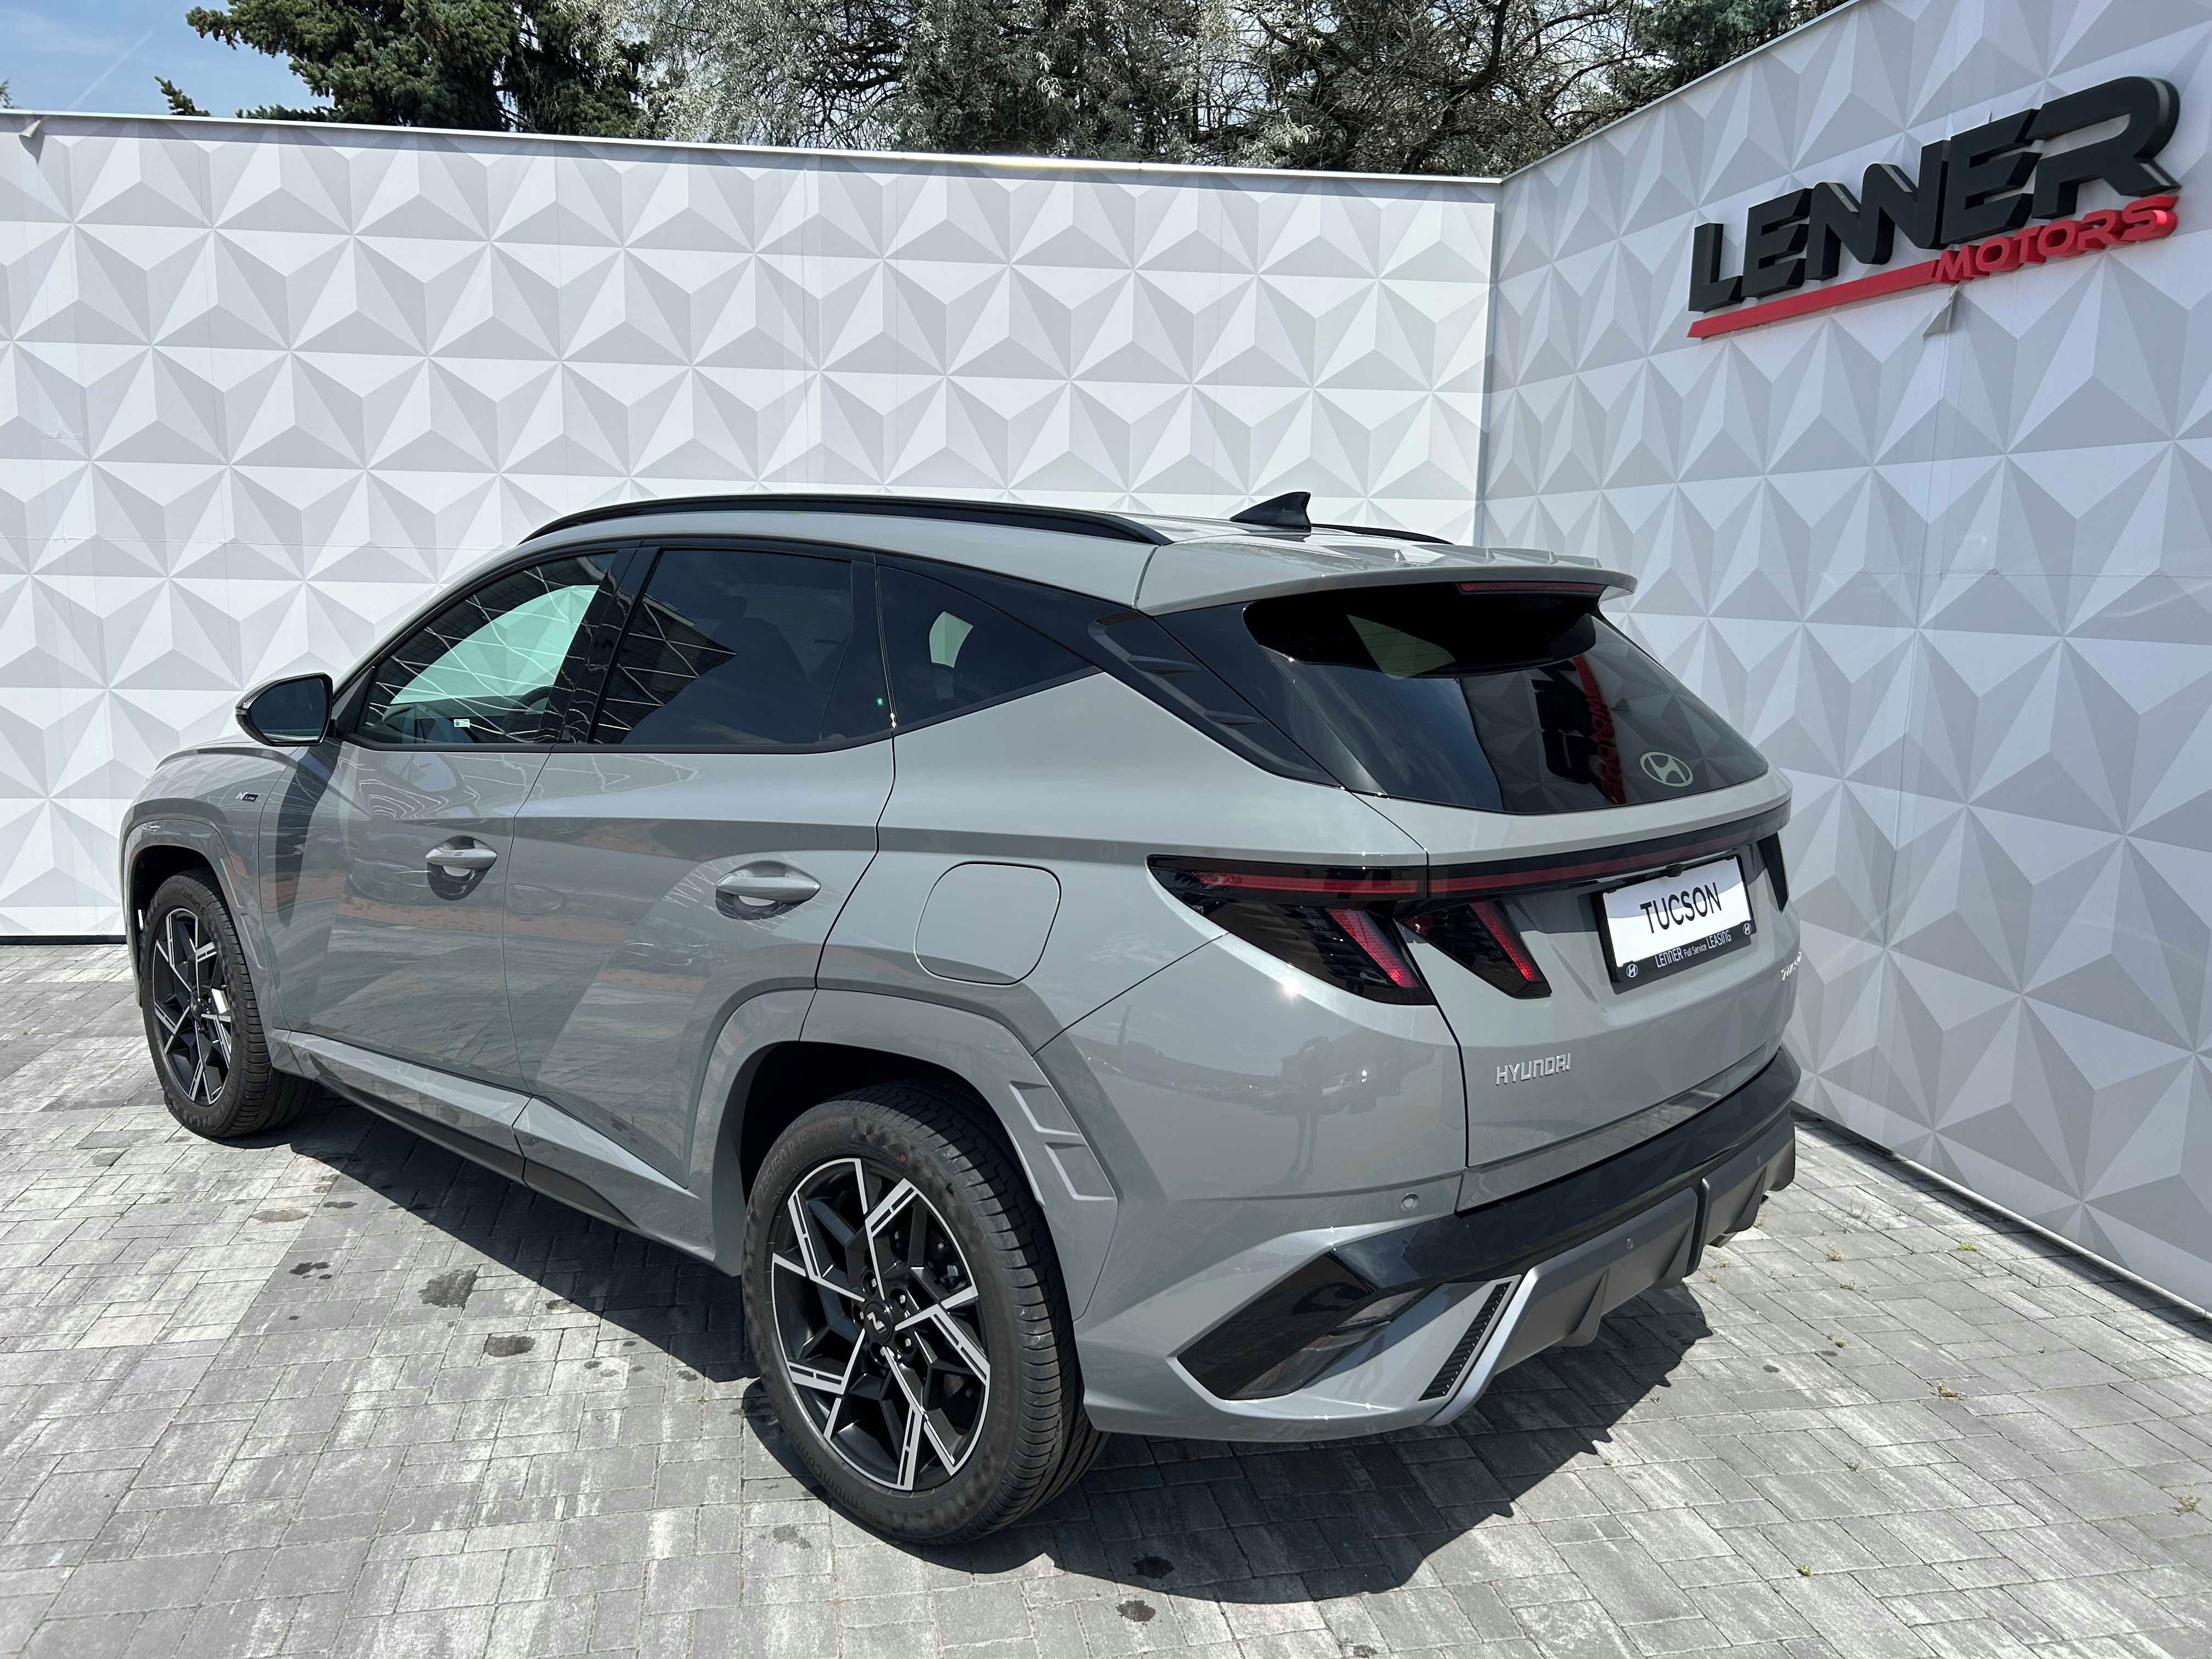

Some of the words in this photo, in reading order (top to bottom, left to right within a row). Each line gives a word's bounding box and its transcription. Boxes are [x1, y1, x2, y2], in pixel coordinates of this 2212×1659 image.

[1688, 76, 2182, 313] LENNER
[1931, 195, 2179, 285] MOTORS
[1639, 882, 1722, 934] TUCSON
[1655, 946, 1684, 968] LENNER
[1684, 948, 1693, 958] Full
[1692, 943, 1707, 955] Service
[1706, 930, 1732, 949] LEASING
[1496, 1053, 1571, 1085] HYUNDAI
